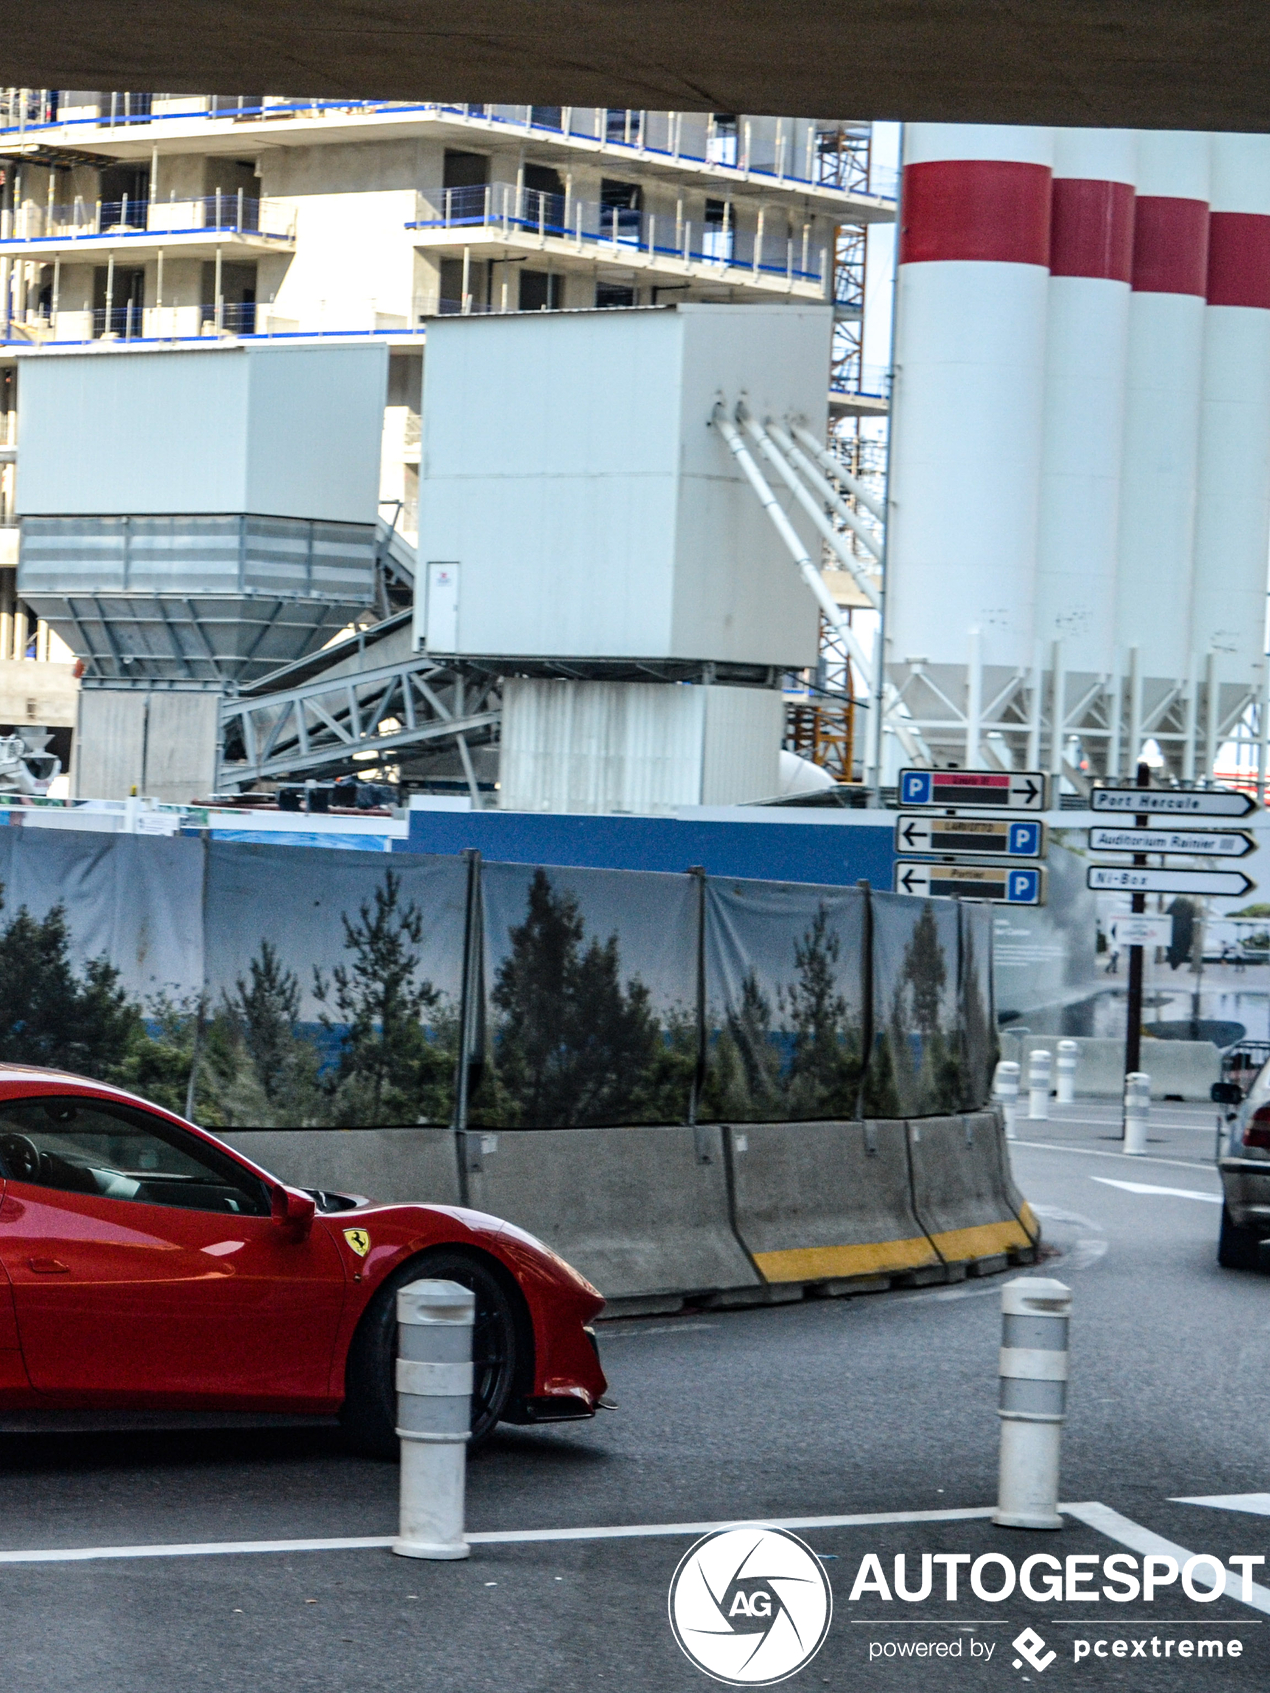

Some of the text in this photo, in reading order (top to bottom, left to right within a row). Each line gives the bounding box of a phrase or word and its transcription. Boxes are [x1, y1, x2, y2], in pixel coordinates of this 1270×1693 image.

[909, 778, 924, 797] P
[1098, 793, 1200, 809] Port Hercule
[1015, 829, 1031, 848] P
[1098, 833, 1166, 847] Auditorium
[1170, 836, 1216, 849] Rainier
[1014, 876, 1030, 896] P
[1095, 872, 1148, 885] Ni-Box
